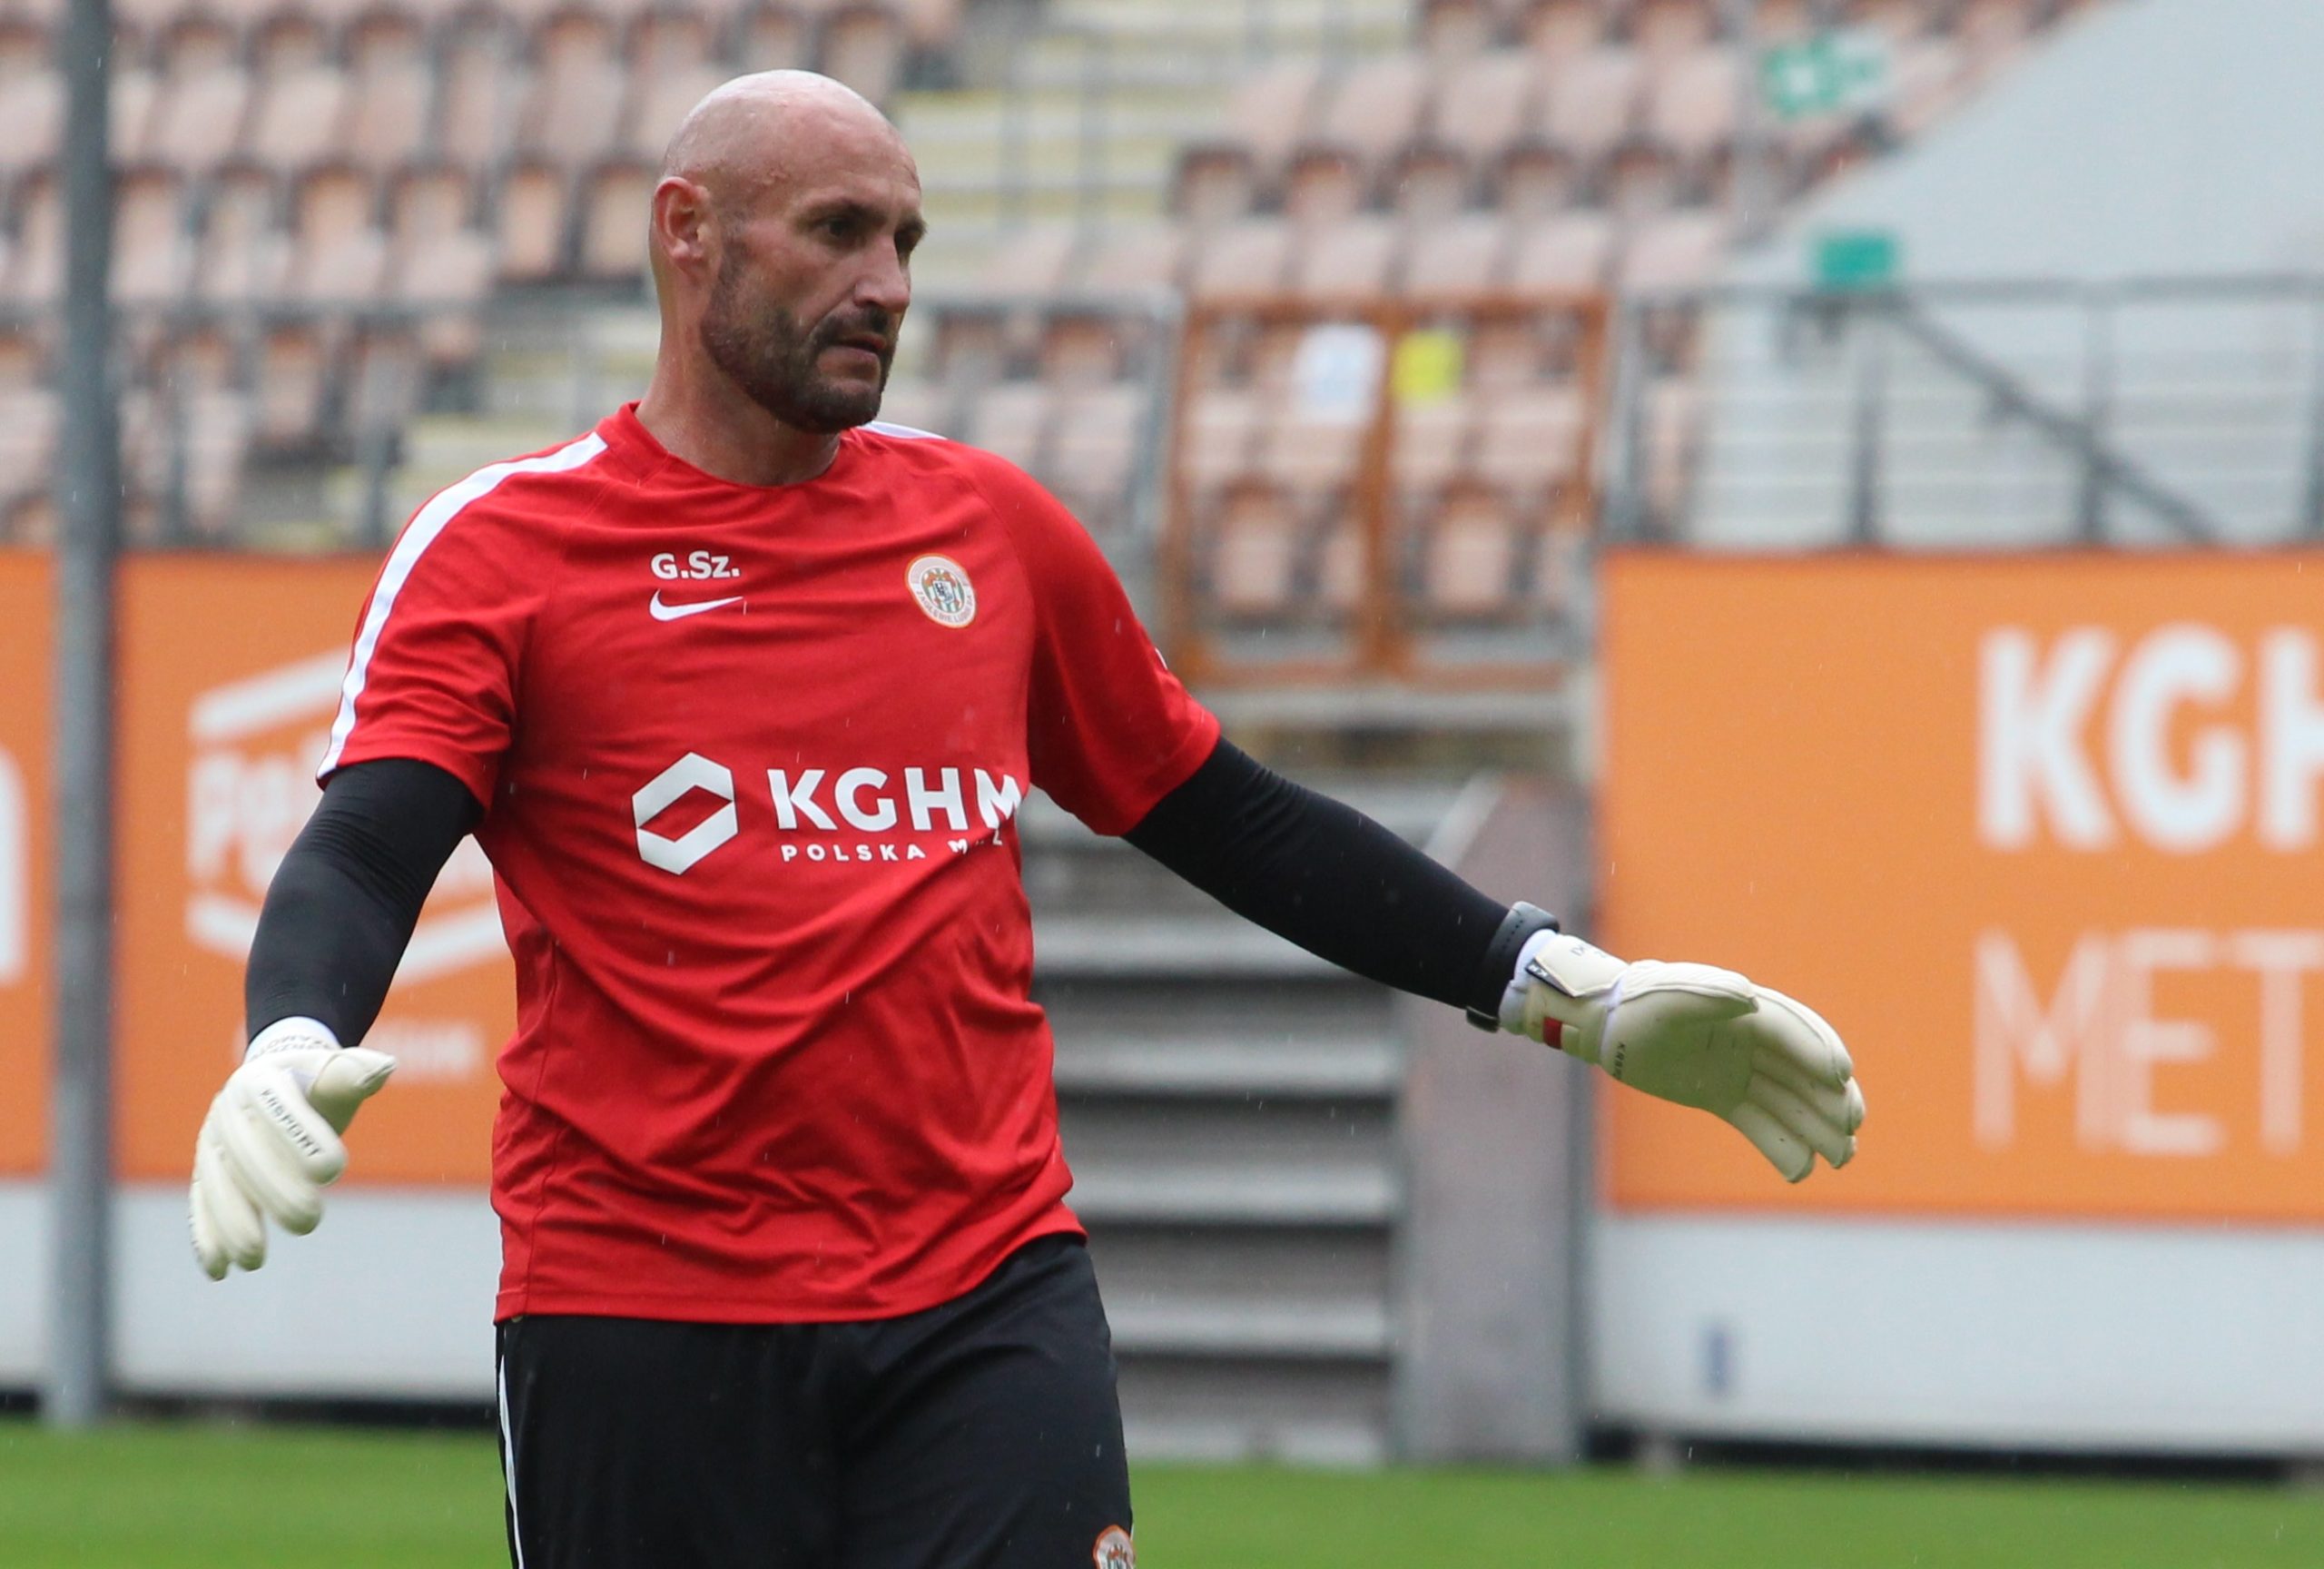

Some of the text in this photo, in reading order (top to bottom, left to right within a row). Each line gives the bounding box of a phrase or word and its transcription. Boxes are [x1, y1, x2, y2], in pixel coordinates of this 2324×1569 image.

[651, 550, 741, 579] G.Sz.
[767, 766, 1022, 832] KGHM
[781, 844, 926, 862] POLSKA
